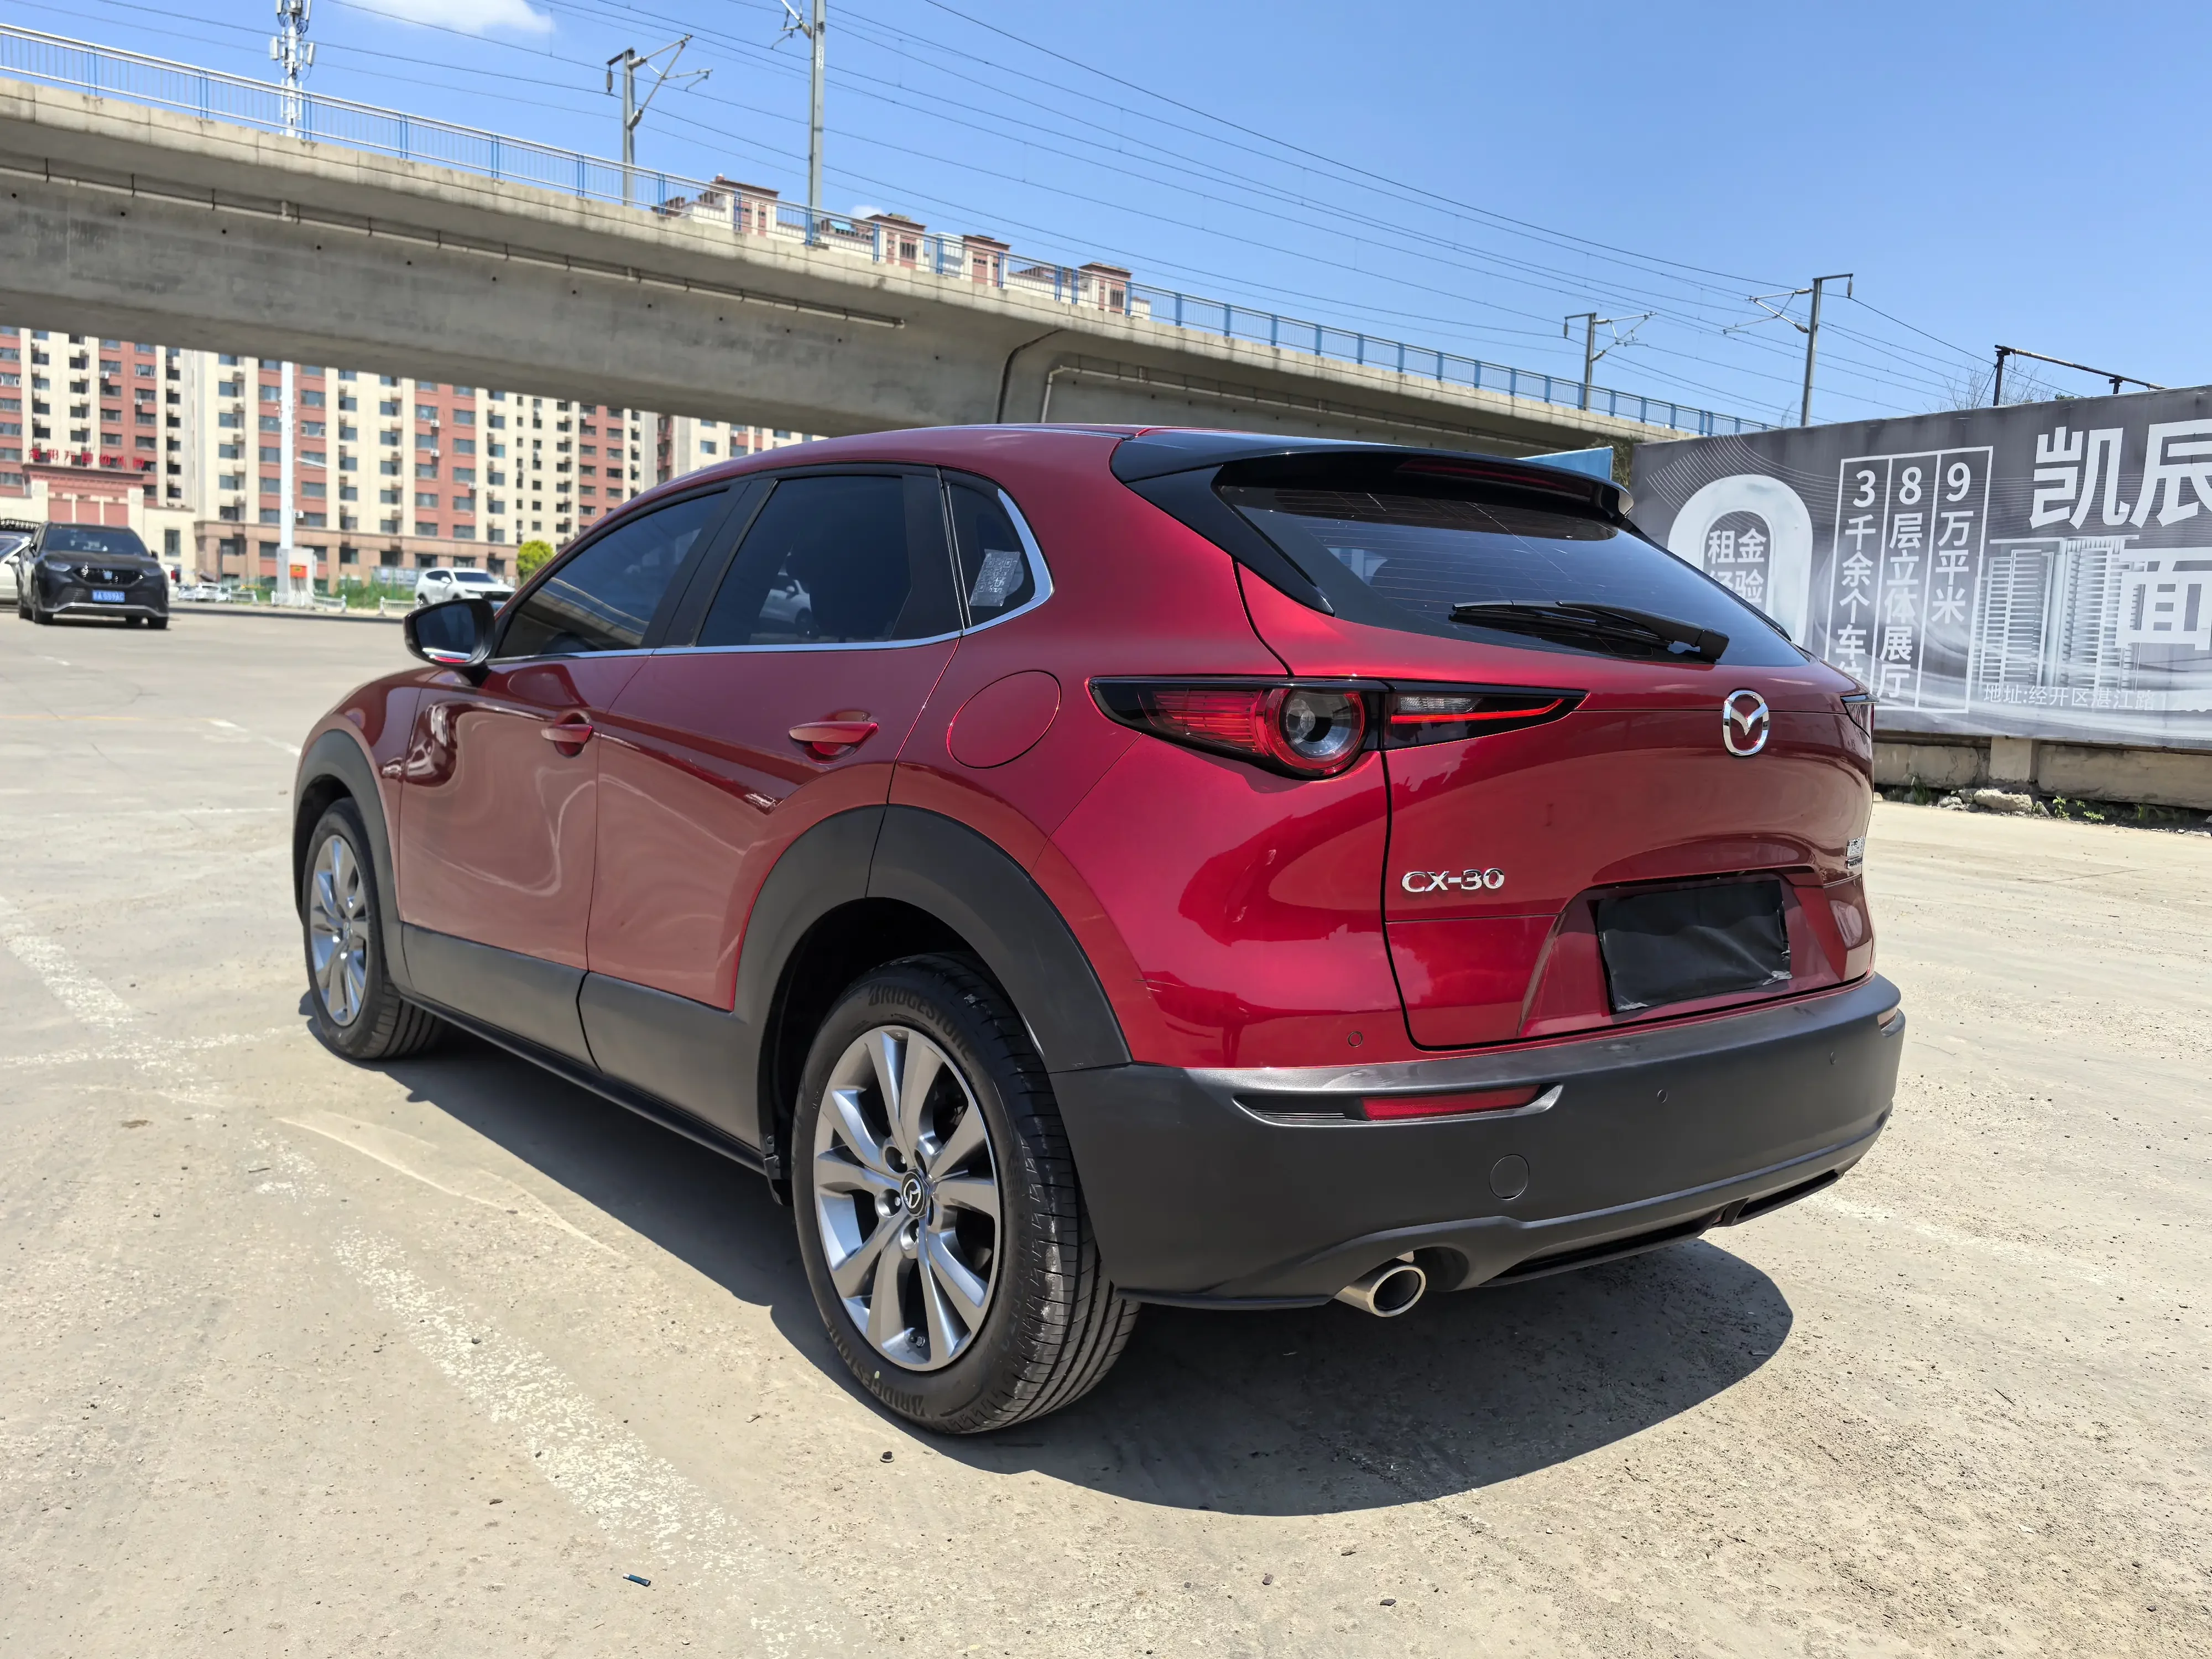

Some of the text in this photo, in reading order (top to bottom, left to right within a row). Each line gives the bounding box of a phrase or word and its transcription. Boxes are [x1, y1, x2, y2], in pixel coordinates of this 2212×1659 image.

[2029, 419, 2212, 530] 凯辰
[1708, 527, 1767, 564] 租金
[1876, 466, 1923, 698] 8层立体展厅
[1931, 462, 1974, 624] 9万平米
[1402, 868, 1505, 893] CX-30
